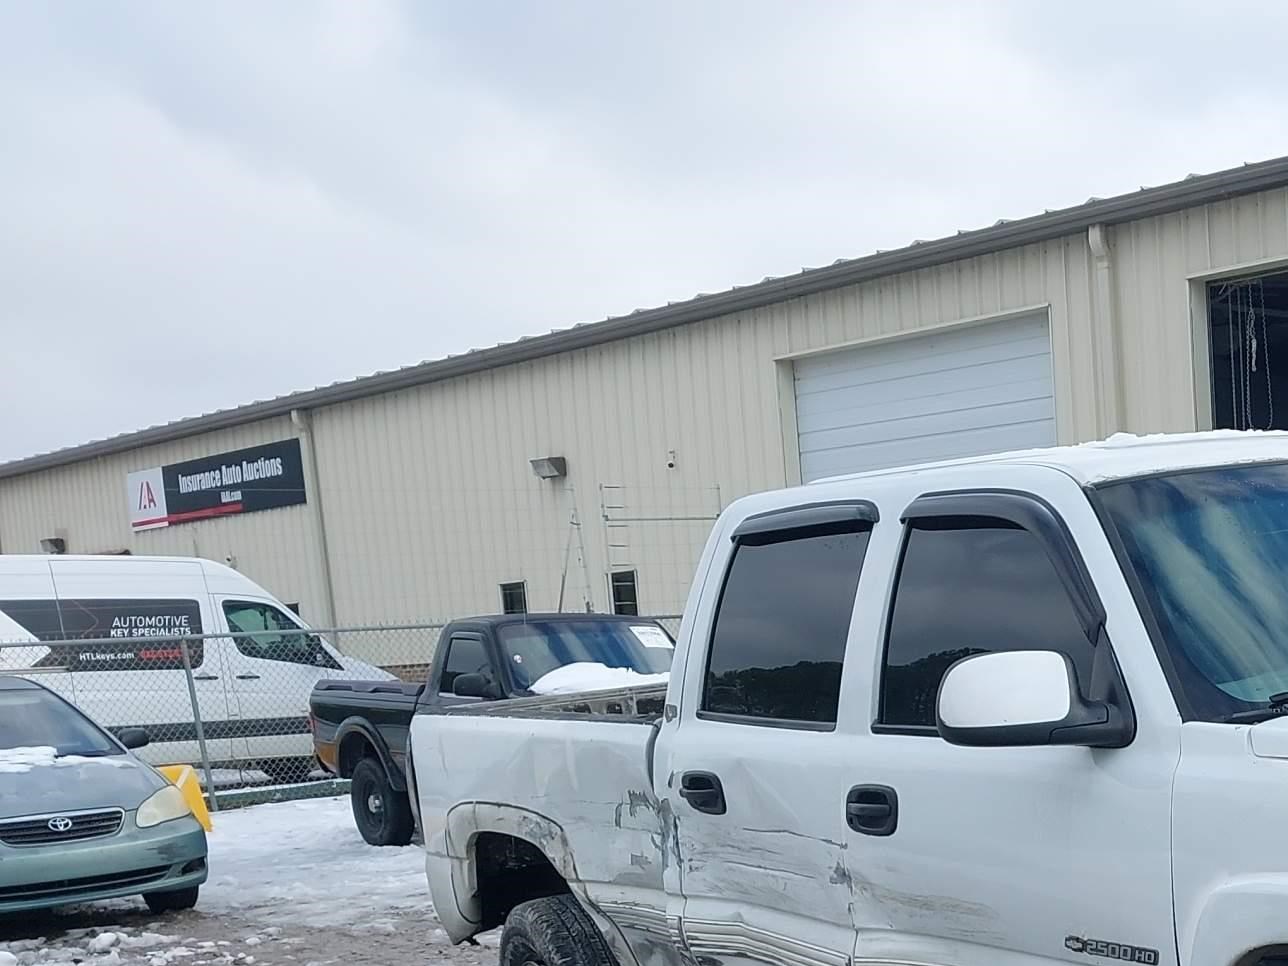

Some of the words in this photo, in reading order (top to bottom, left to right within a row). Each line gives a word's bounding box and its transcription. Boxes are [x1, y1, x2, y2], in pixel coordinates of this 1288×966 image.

[178, 469, 221, 494] Insurance
[221, 464, 242, 486] Auto
[242, 457, 283, 482] Auctions
[112, 615, 189, 628] AUTOMOTIVE
[110, 628, 129, 637] KEY
[132, 627, 191, 637] SPECIALISTS
[1086, 940, 1131, 959] 2500
[1135, 949, 1154, 963] HD
